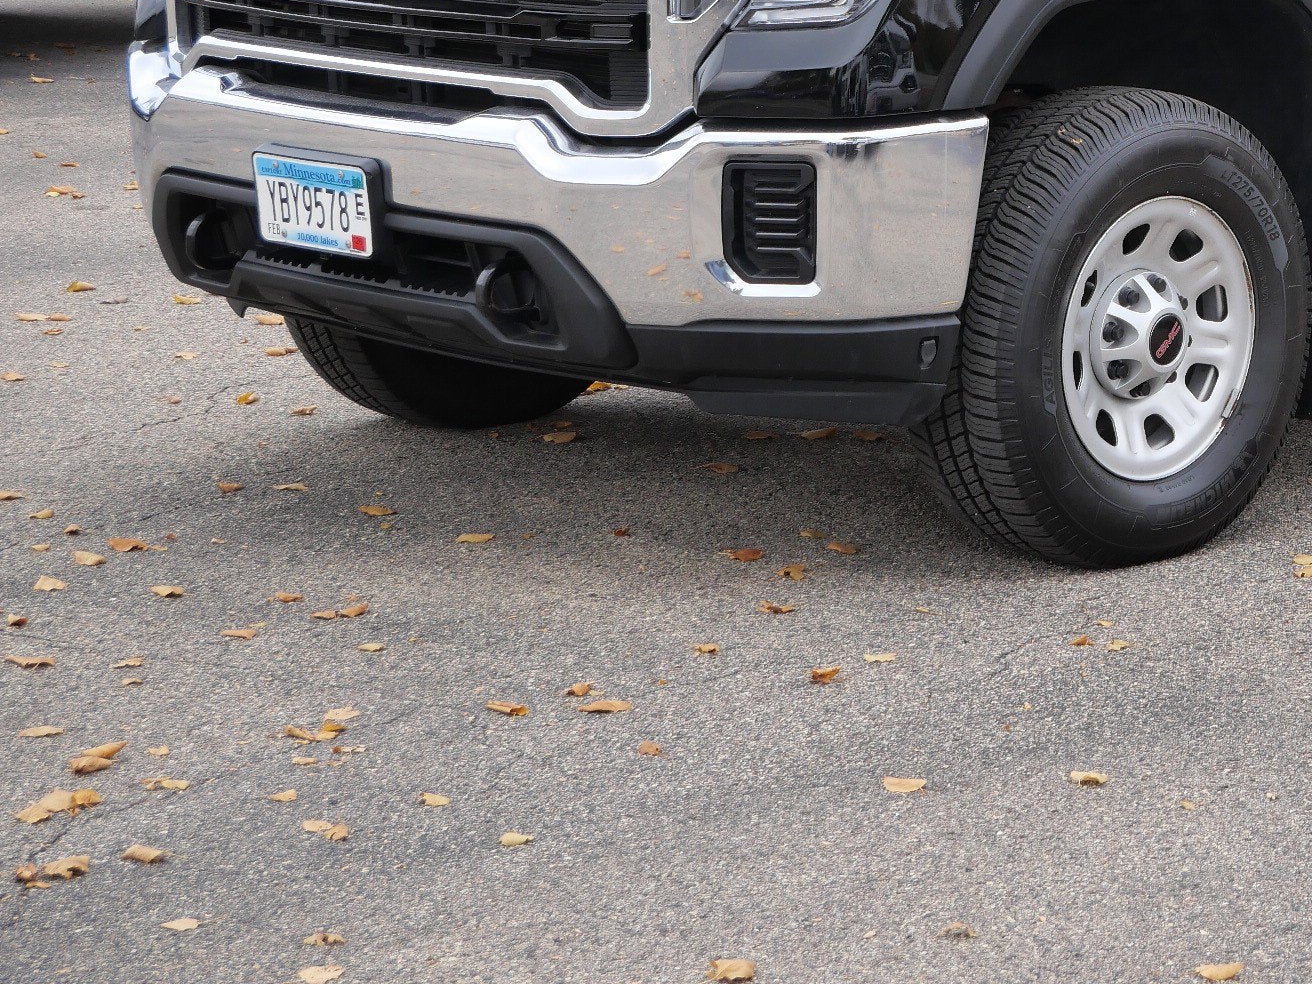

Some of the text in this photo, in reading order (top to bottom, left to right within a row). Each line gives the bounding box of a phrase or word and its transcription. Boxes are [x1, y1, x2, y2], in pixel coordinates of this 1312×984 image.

[266, 180, 350, 232] YBY9578
[268, 223, 281, 235] FEB
[297, 232, 339, 246] 10,000 lakes
[1155, 321, 1180, 359] GMC
